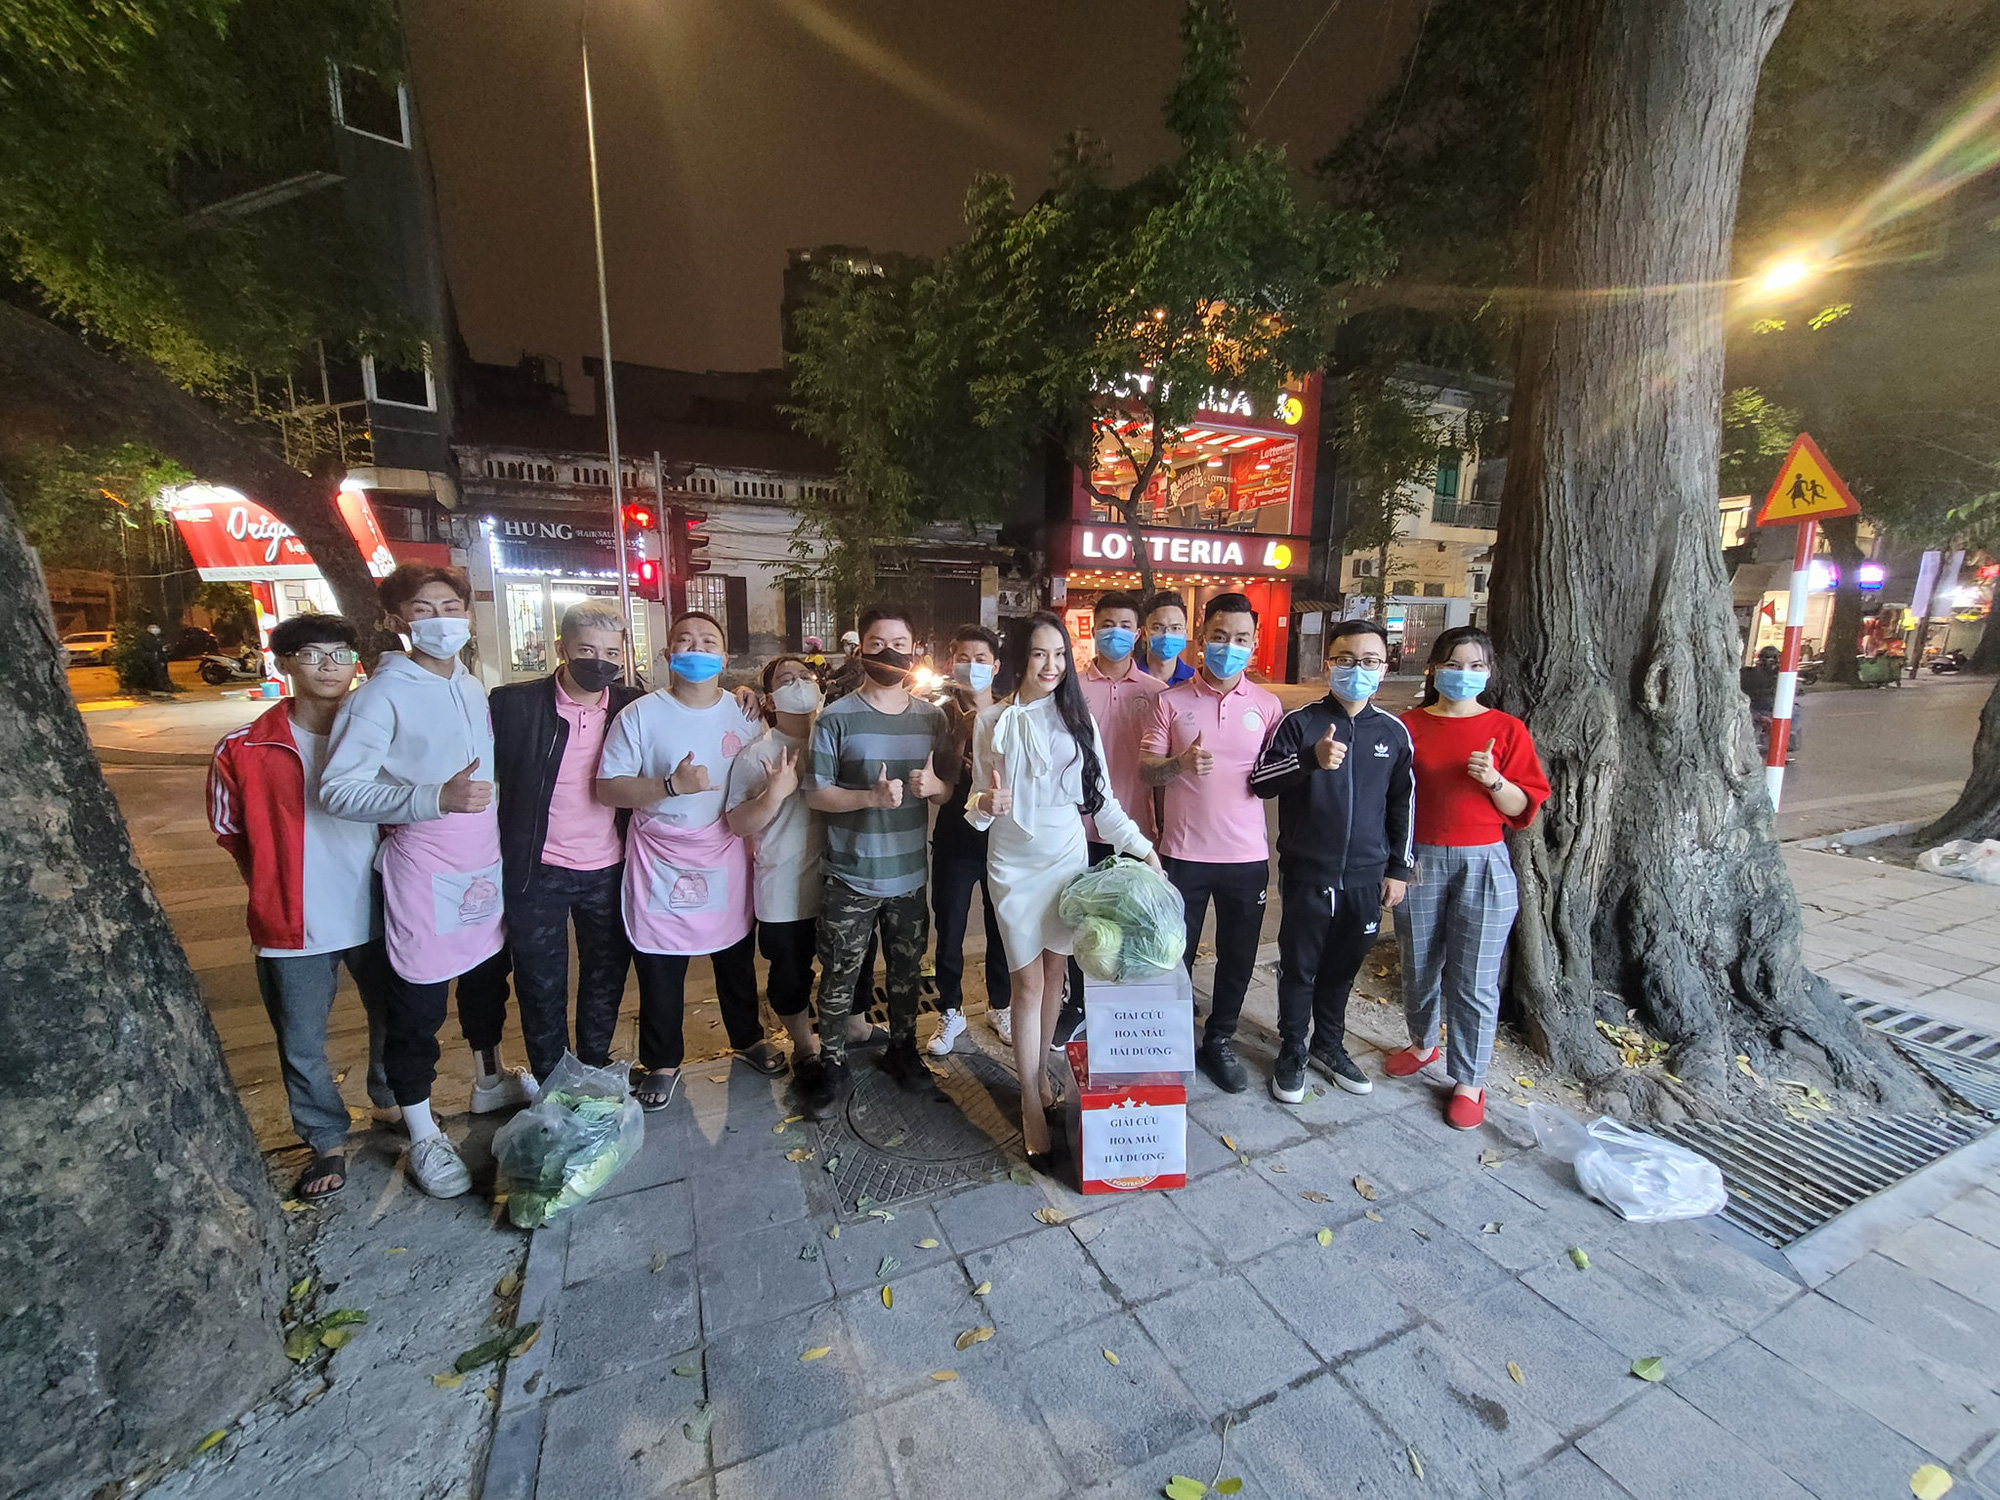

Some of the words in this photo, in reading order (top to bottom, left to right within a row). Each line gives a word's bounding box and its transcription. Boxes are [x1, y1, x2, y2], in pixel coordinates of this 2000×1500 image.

[226, 506, 297, 562] Origa
[1082, 531, 1244, 566] LOTERIA
[1115, 1030, 1138, 1038] HOA
[1109, 1136, 1133, 1145] HOA
